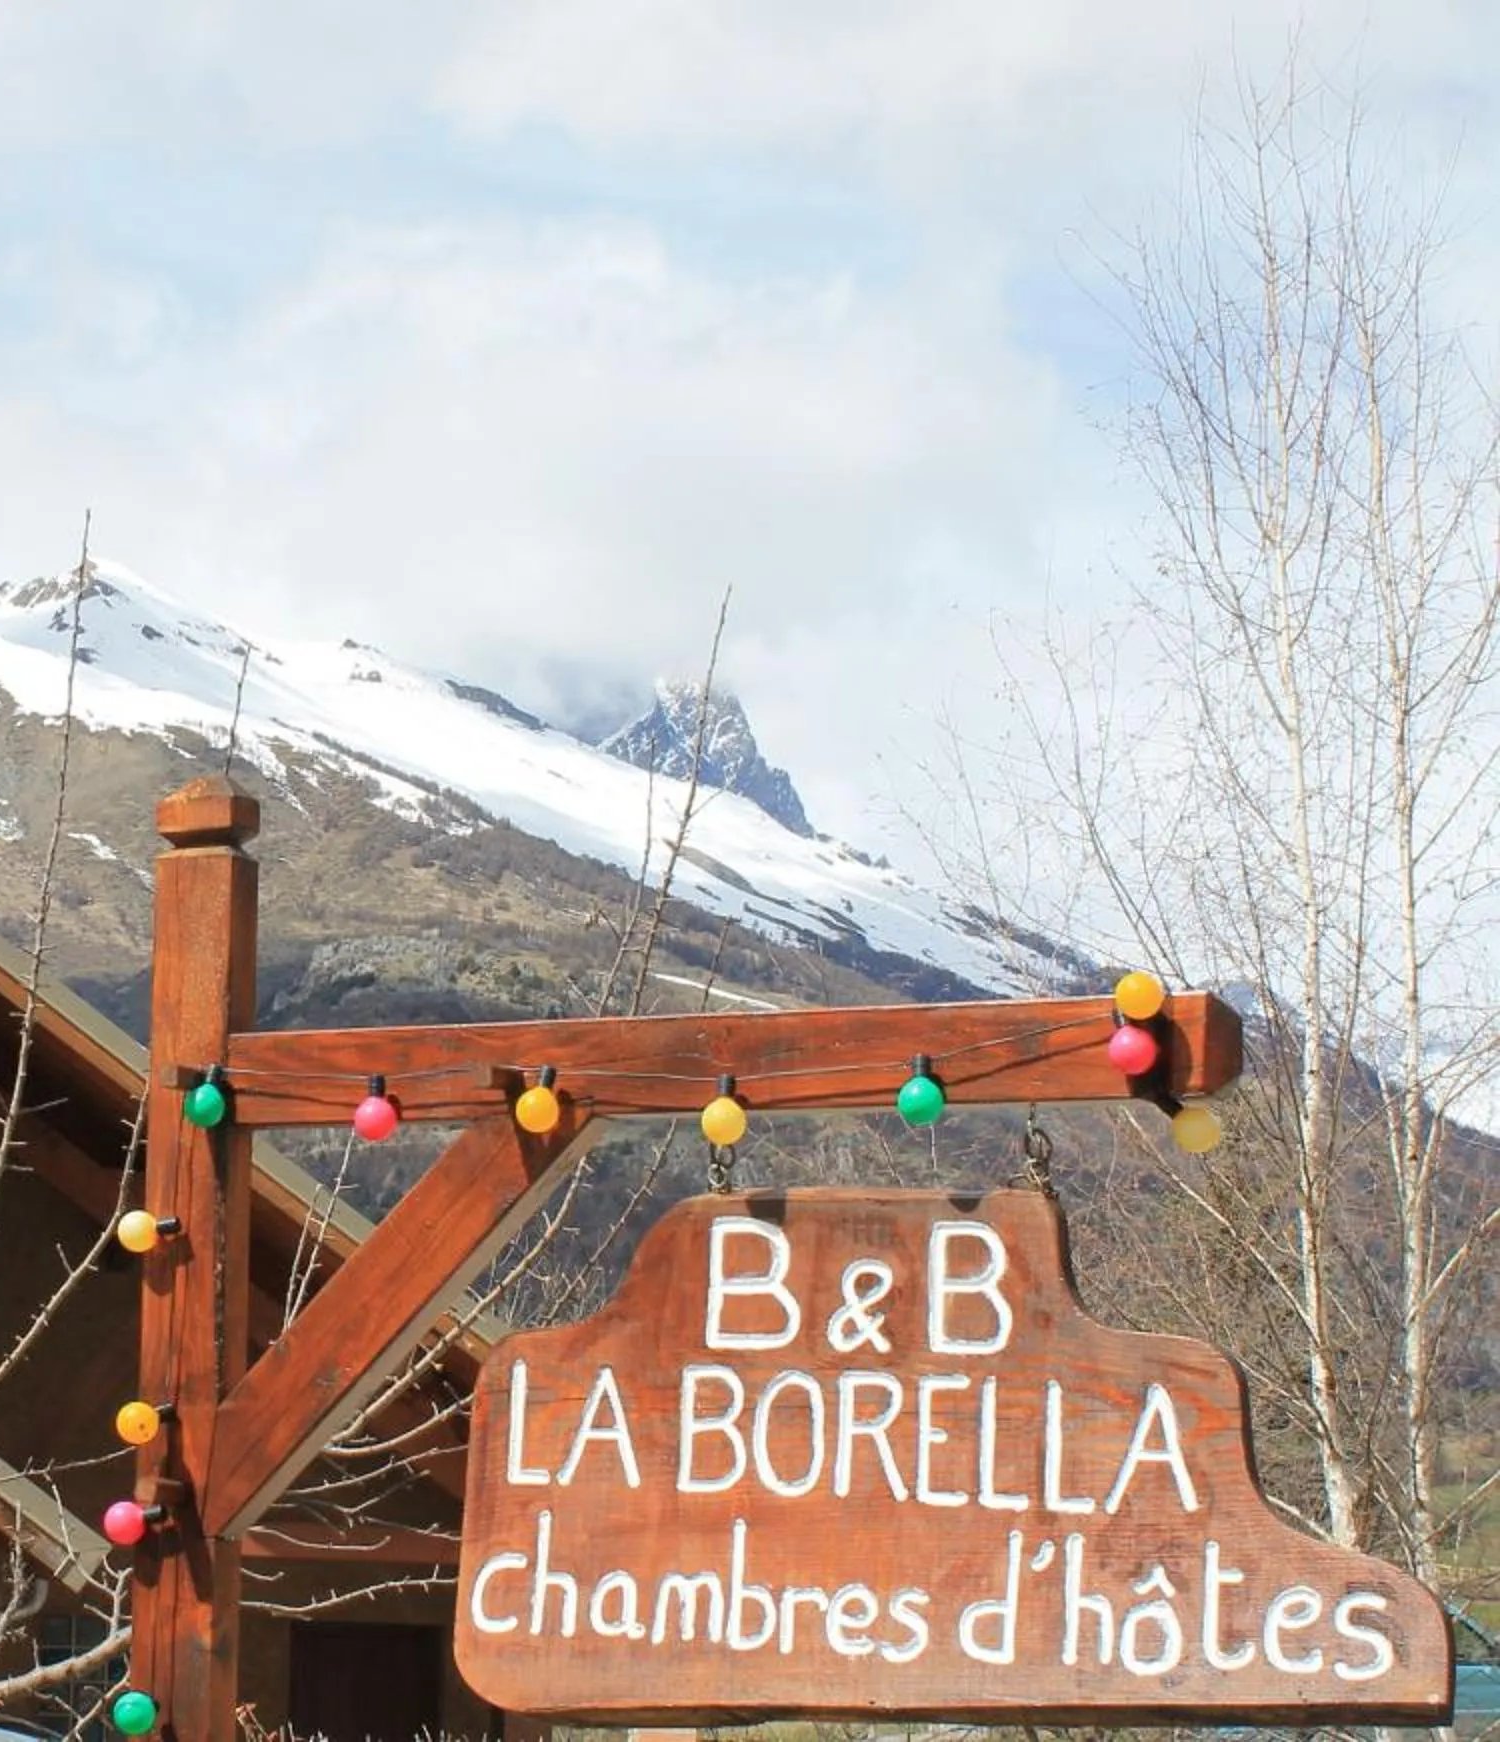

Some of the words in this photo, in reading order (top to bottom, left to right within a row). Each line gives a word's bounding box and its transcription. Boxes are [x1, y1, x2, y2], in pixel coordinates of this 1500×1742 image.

[705, 1215, 802, 1351] B
[826, 1258, 893, 1354] &
[927, 1219, 1014, 1357] B
[505, 1358, 642, 1490] LA
[675, 1363, 1201, 1516] BORELLA
[468, 1509, 931, 1667] chambres
[956, 1527, 1396, 1684] d'hôtes
